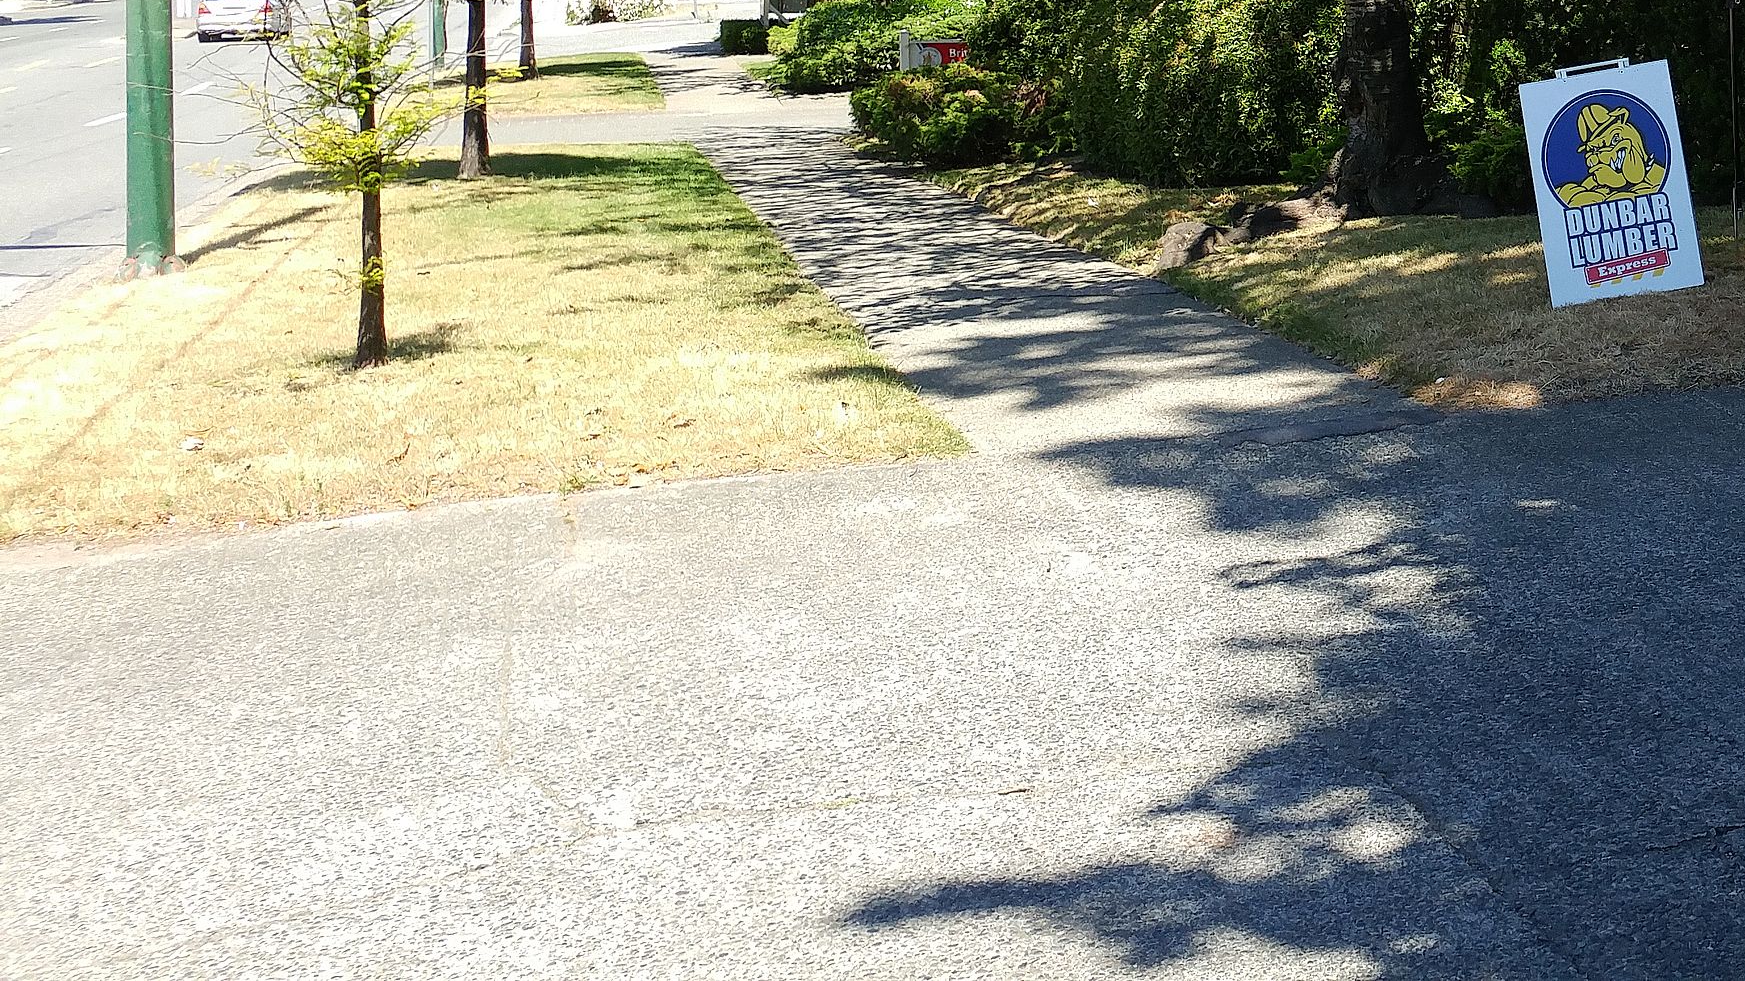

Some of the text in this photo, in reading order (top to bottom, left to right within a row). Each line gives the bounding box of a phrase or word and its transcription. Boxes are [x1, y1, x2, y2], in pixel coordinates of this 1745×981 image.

[1565, 193, 1670, 237] DUNBAR
[1569, 221, 1677, 267] LUMBER
[1597, 256, 1657, 278] Express
